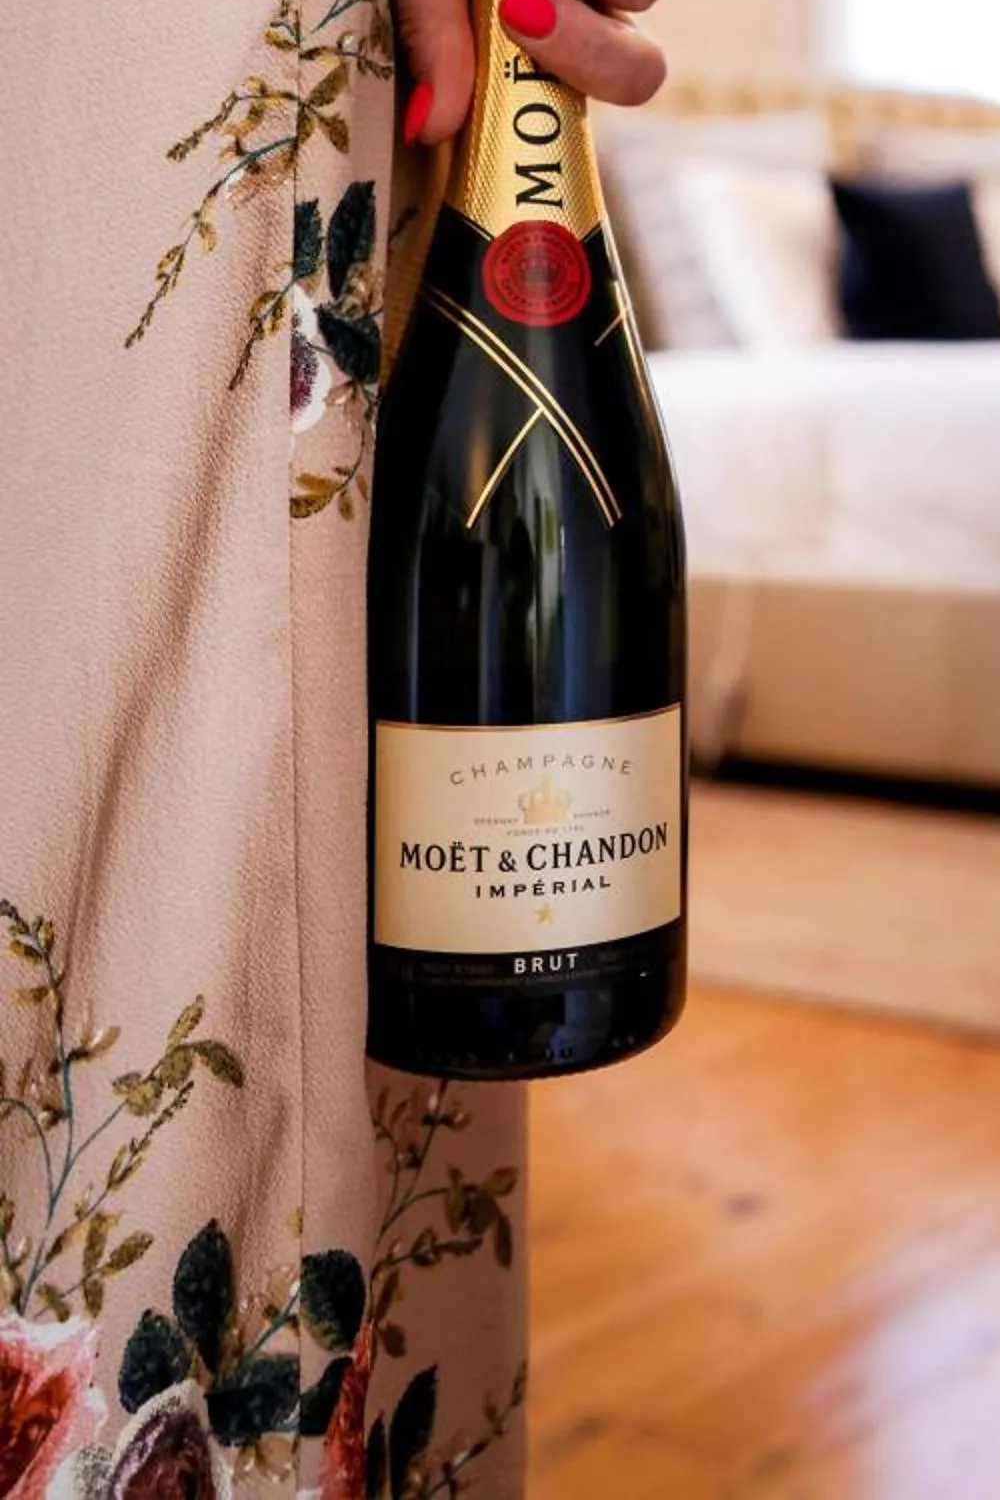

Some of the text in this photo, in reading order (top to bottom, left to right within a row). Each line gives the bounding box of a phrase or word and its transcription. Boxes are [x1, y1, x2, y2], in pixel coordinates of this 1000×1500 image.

[450, 754, 634, 786] CHAMPAGNE
[400, 822, 669, 873] MOËT & CHANDON
[476, 875, 611, 899] IMPÉRIAL
[514, 952, 580, 975] BRUT
